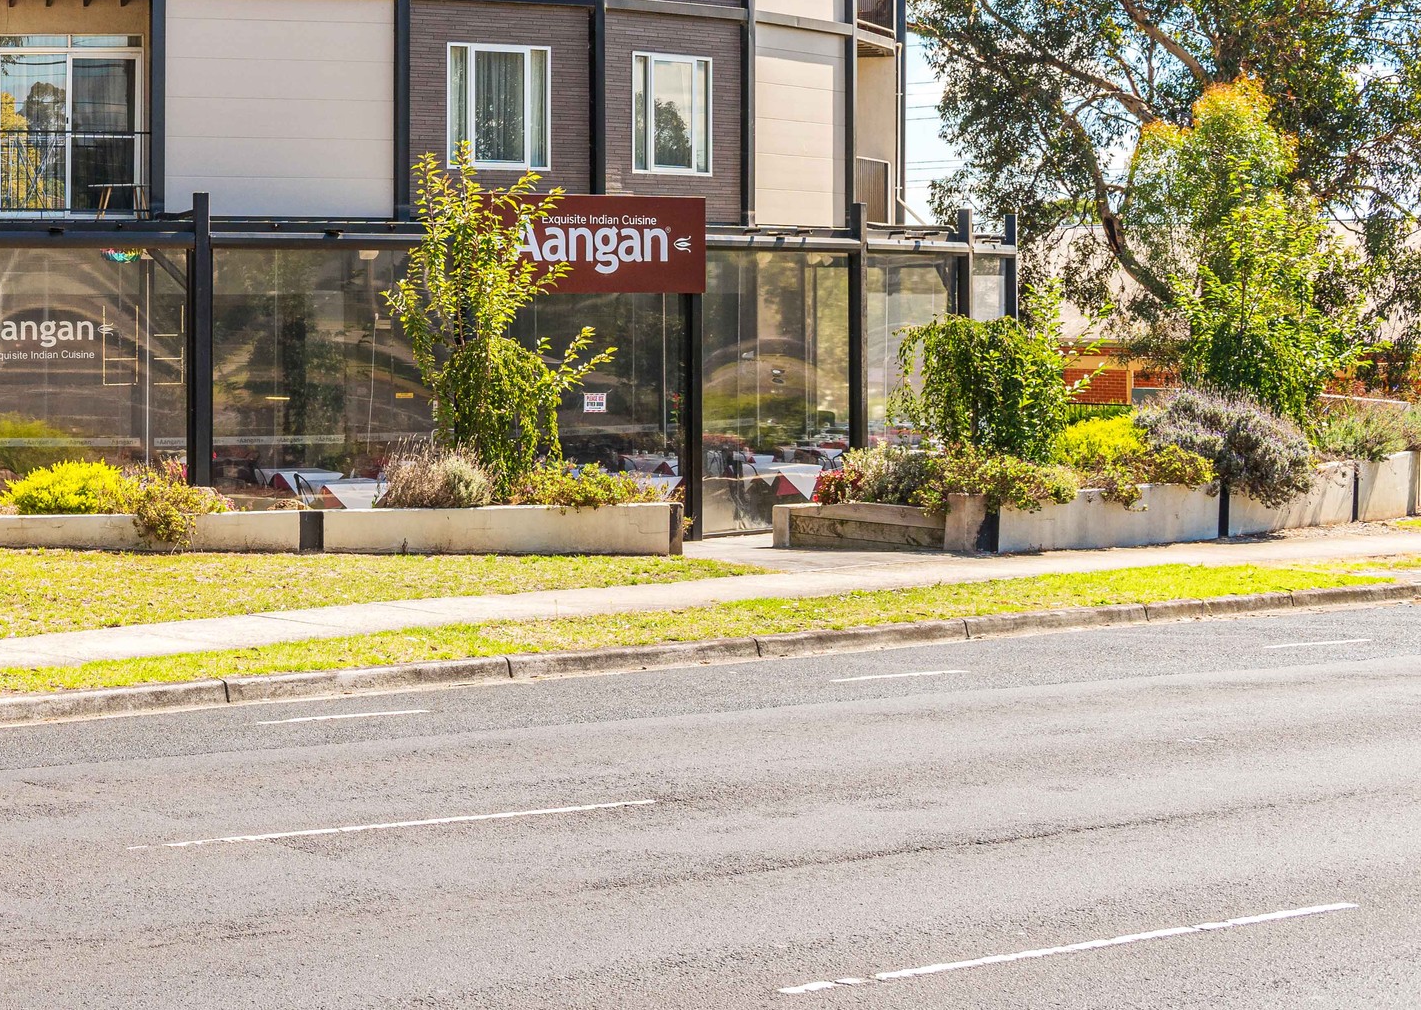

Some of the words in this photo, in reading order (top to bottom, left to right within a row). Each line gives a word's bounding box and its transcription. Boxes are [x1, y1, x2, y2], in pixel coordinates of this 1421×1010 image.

[541, 214, 587, 225] Exquisite
[589, 214, 619, 225] Indian
[621, 215, 657, 225] Cuisine
[515, 215, 669, 274] Aangan
[30, 350, 59, 360] Indian
[61, 349, 95, 360] Cuisine
